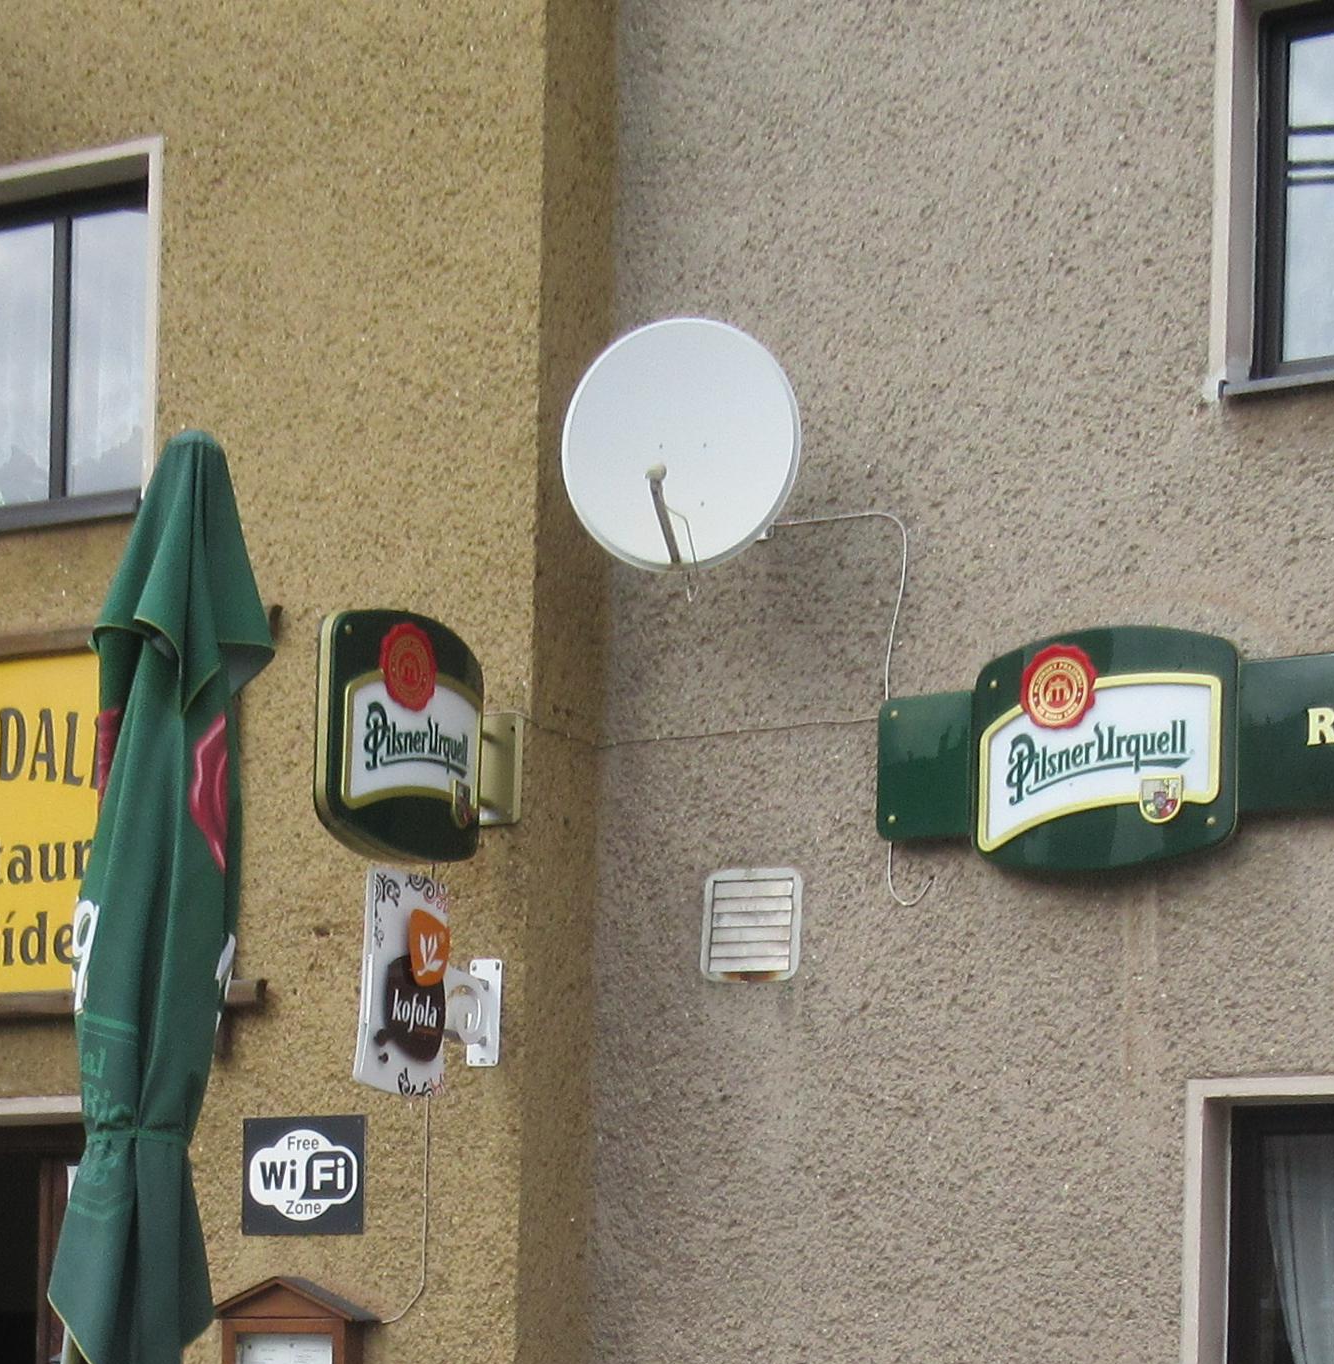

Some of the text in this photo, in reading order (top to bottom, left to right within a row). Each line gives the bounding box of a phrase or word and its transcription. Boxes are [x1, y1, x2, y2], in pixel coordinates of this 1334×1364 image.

[363, 701, 468, 774] Pilsner Urquell
[1005, 720, 1187, 806] Pilsner Urquell
[391, 988, 438, 1034] kofola
[286, 1136, 320, 1151] Free
[284, 1200, 322, 1215] Zone
